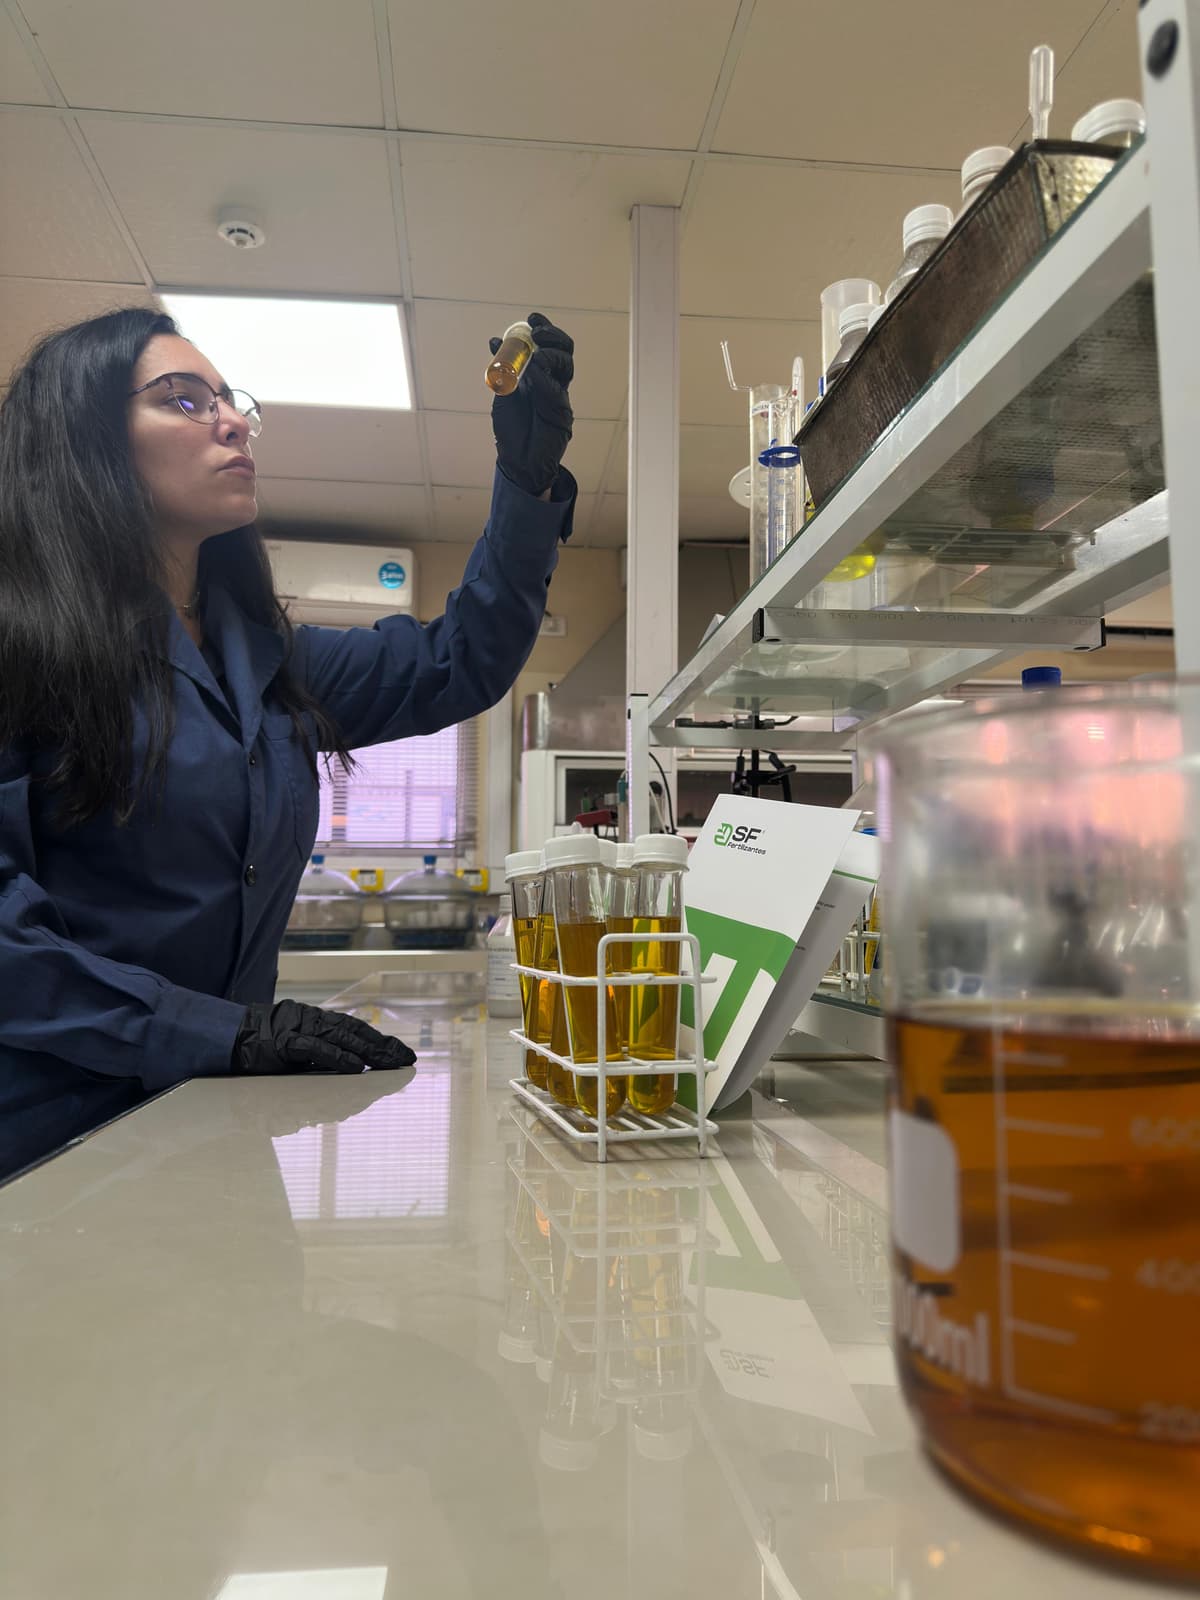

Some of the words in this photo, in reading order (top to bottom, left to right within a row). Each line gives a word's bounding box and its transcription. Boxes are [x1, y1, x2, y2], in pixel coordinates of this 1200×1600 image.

[732, 825, 761, 843] SF
[727, 842, 766, 854] Fertilizantes
[1137, 1400, 1200, 1443] 20
